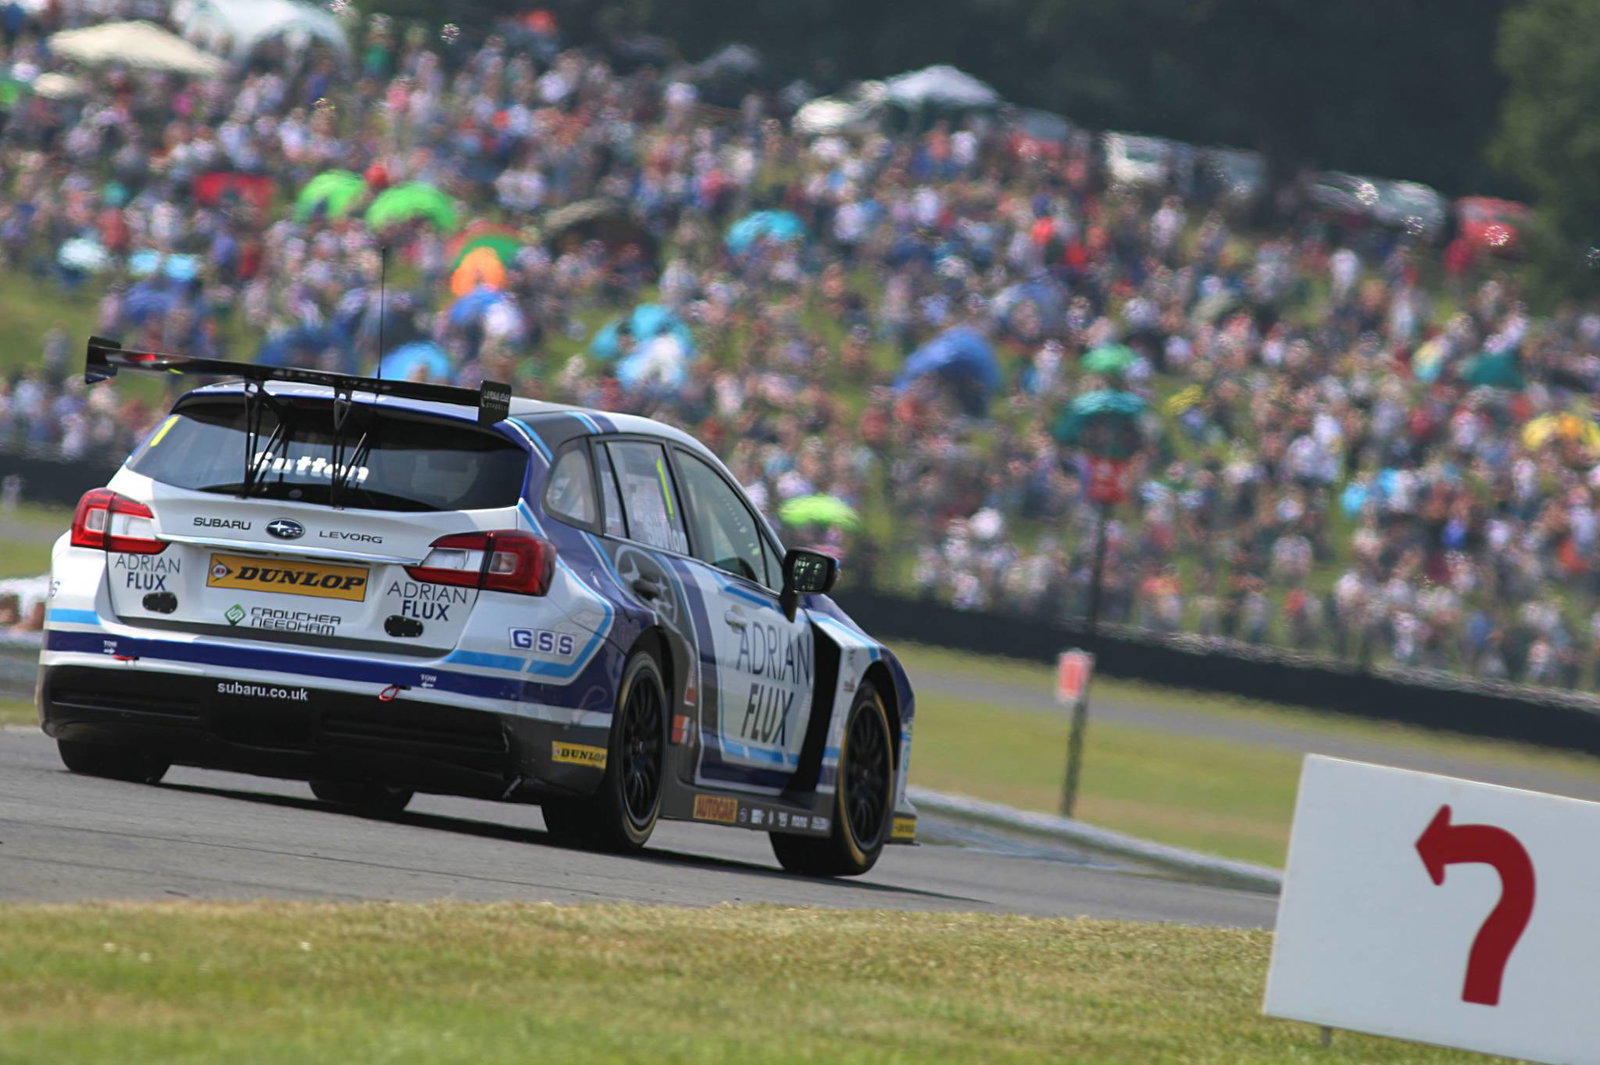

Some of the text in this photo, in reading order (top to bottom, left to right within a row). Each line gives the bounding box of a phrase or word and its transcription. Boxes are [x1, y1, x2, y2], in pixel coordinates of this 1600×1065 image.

[193, 517, 252, 531] SUBARU
[319, 530, 383, 544] LEVORG
[115, 554, 181, 575] ADRIAN
[126, 573, 167, 591] FLUX
[235, 566, 365, 590] DUNLOP
[387, 581, 467, 604] ADRIAN
[251, 607, 341, 625] CROUCHER
[401, 600, 450, 621] FLUX
[251, 616, 335, 636] NEEDHAM
[512, 629, 574, 655] GSS
[736, 621, 810, 688] ADRIAN
[217, 682, 308, 701] subaru.co.uk
[740, 684, 794, 747] FLUX
